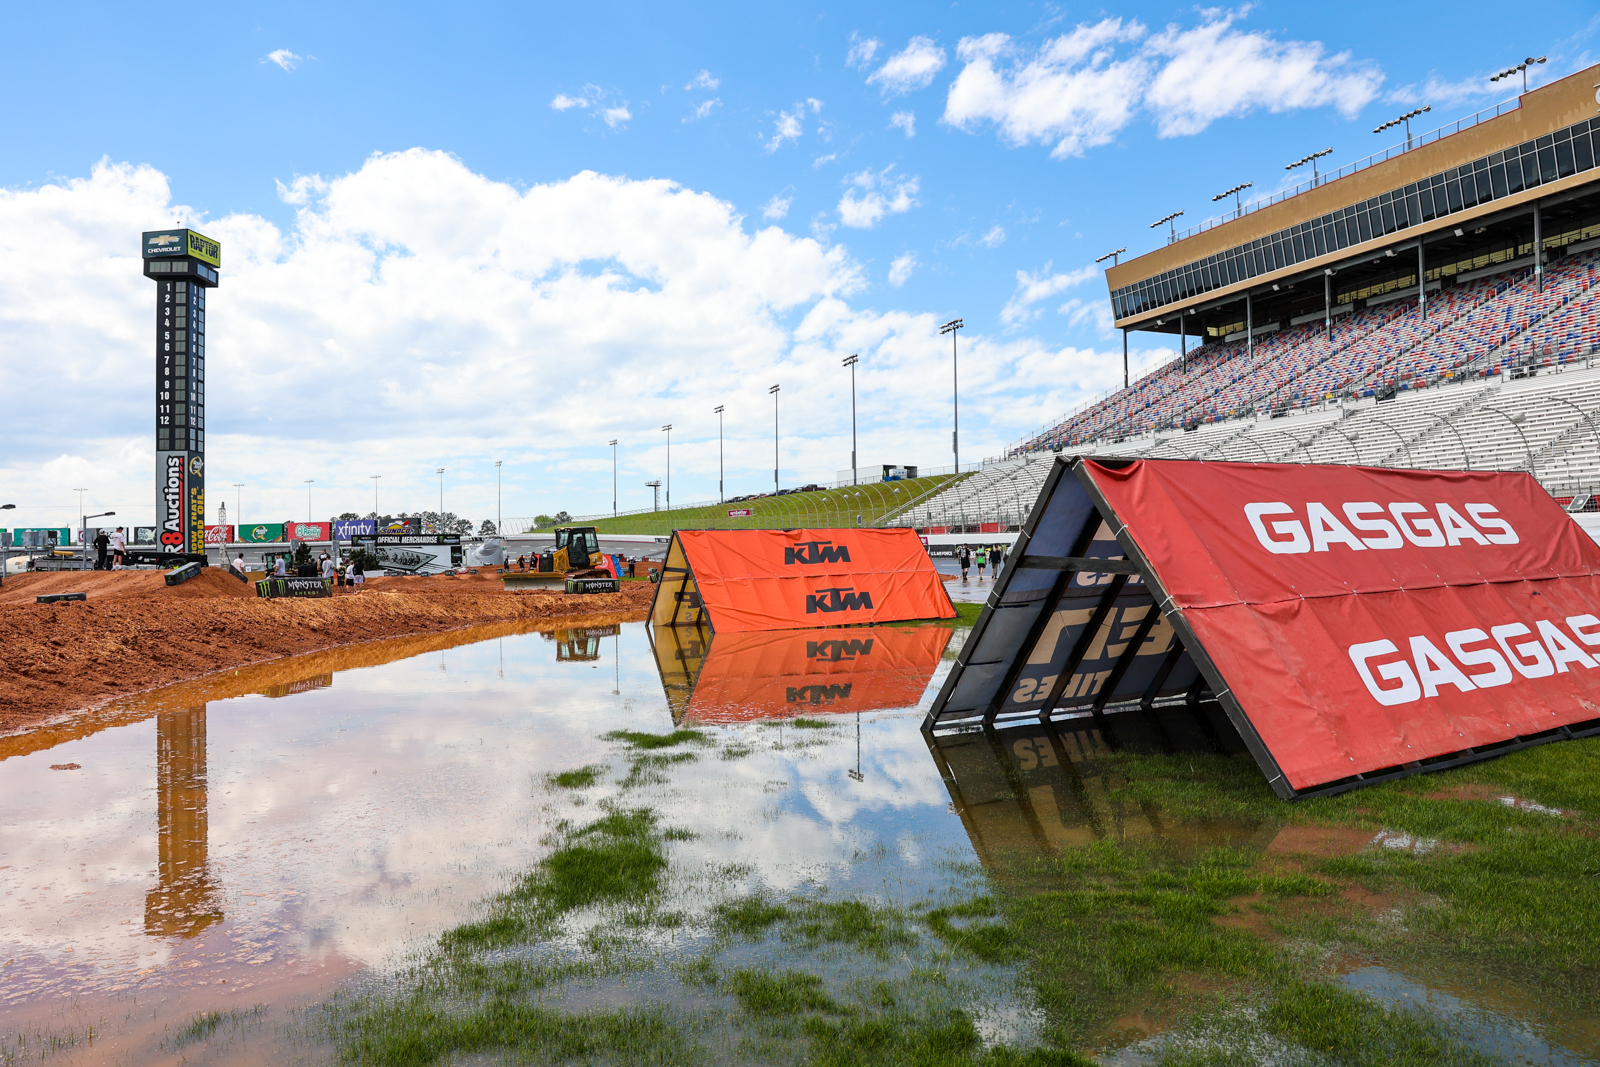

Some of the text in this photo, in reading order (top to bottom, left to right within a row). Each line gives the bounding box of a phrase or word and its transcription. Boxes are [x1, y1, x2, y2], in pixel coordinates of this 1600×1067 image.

[148, 246, 181, 254] CHEVROLET
[189, 234, 218, 259] RAPTOR
[167, 283, 170, 292] 1
[193, 285, 197, 294] 1
[164, 294, 170, 303] 2
[193, 296, 197, 305] 2
[164, 307, 170, 316] 3
[193, 309, 197, 317] 3
[164, 318, 171, 327] 4
[193, 320, 196, 329] 4
[164, 332, 170, 340] 5
[164, 343, 170, 352] 6
[164, 356, 170, 364] 7
[193, 357, 196, 366] 7
[164, 367, 170, 376] 8
[164, 380, 170, 389] 9
[160, 391, 170, 401] 10
[160, 404, 170, 414] 11
[190, 405, 196, 414] 11
[160, 416, 170, 425] 12
[190, 416, 196, 426] 12
[338, 522, 371, 539] xfinity
[1244, 502, 1520, 554] GASGAS
[785, 540, 851, 565] KTM
[288, 580, 323, 590] MONSTER
[806, 587, 873, 614] KTM
